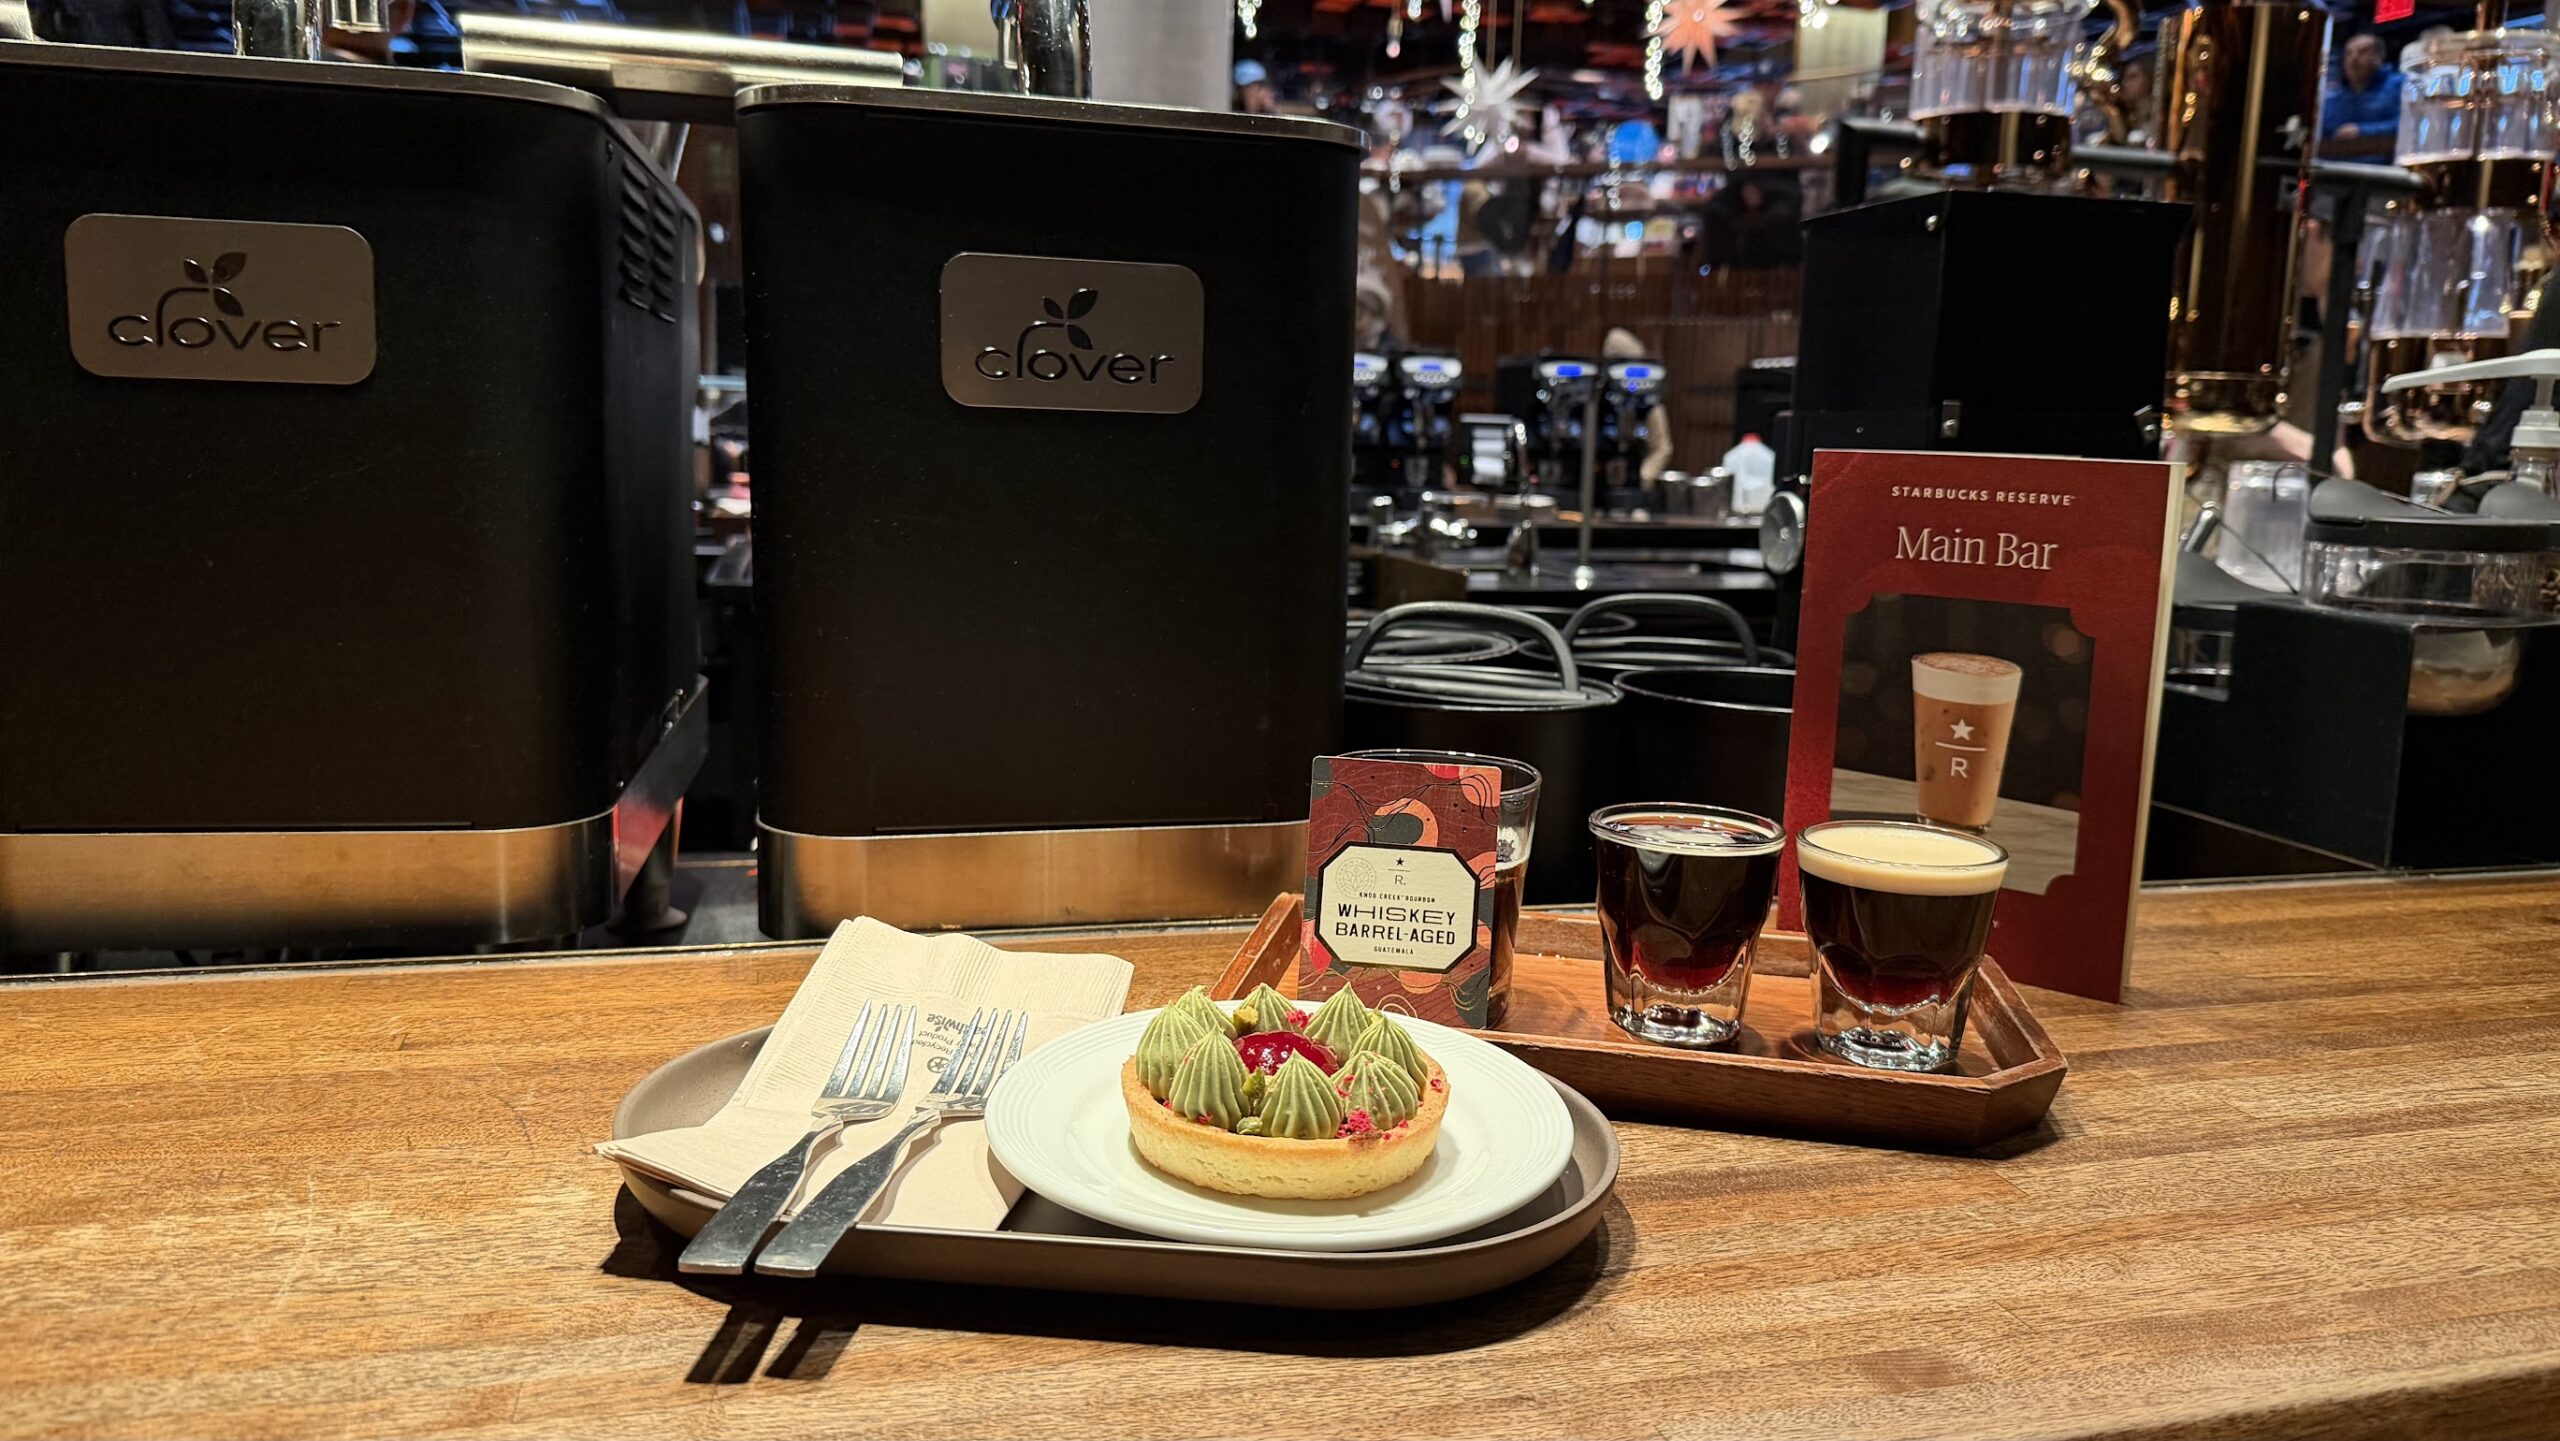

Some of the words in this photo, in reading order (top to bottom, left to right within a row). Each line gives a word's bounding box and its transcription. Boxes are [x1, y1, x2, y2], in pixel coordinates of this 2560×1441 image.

[108, 286, 342, 353] clover
[975, 320, 1175, 384] clover
[1891, 486, 1989, 501] STARBUCKS
[1895, 526, 1986, 565] Main
[1994, 532, 2059, 571] Bar
[1950, 757, 1968, 779] R
[1405, 895, 1436, 903] BOURBON
[1338, 902, 1456, 926] WHISKEY
[1335, 922, 1456, 945] BARREL-AGED
[1373, 945, 1414, 955] GUATEMALA
[918, 1030, 954, 1046] Product
